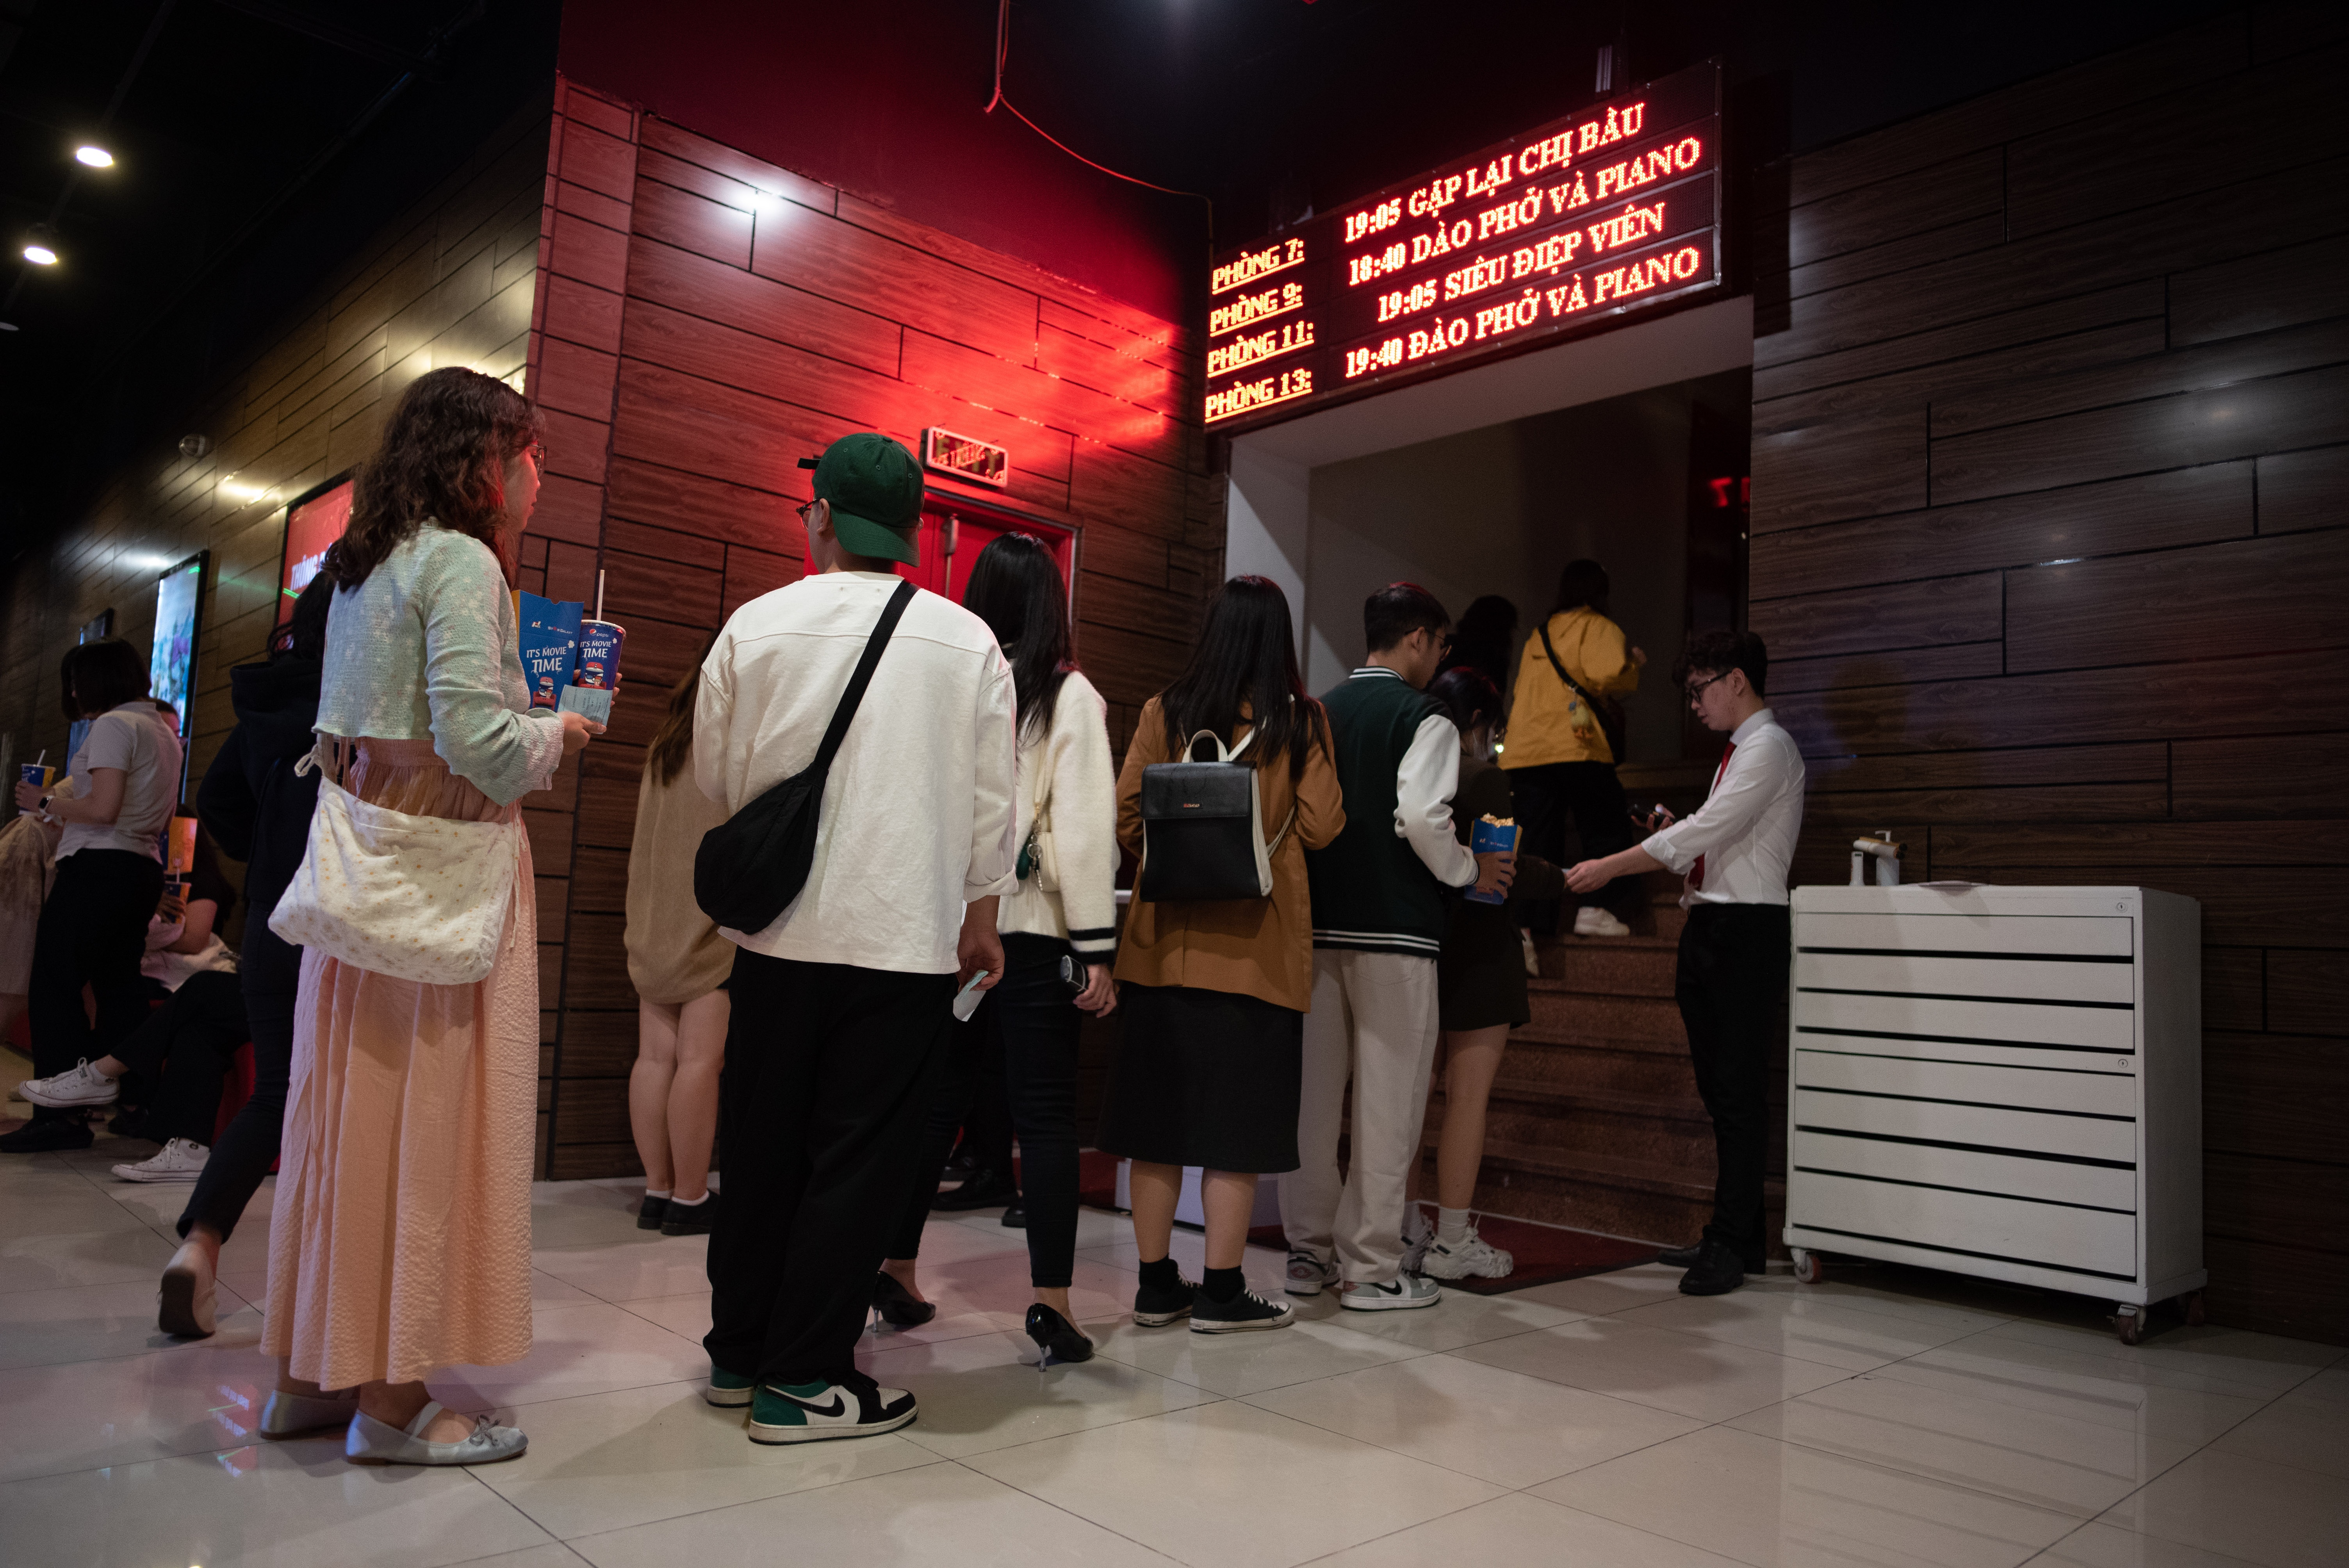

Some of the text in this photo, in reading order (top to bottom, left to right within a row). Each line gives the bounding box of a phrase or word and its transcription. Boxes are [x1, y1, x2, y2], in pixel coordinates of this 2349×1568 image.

[1346, 198, 1401, 242] 19:05
[1409, 175, 1461, 217] GẶP
[1466, 155, 1512, 197] LẠI
[1519, 130, 1573, 175] CHỊ
[1349, 243, 1406, 286] 18:40
[1478, 187, 1543, 241] PHỞ
[1548, 171, 1590, 214] VÀ
[1596, 137, 1700, 200] PIANO
[1212, 239, 1304, 290] PHÒNG 7:
[1378, 202, 1665, 322] 19:05 SIÊU ĐIỆP VIÊN
[1210, 283, 1302, 333] PHÒNG 9:
[1346, 247, 1699, 378] 19:40 ĐÀO PHỞ VÀ PIANO
[1208, 321, 1314, 372] PHÒNG 11:
[1205, 369, 1312, 418] PHÒNG 13:
[526, 646, 567, 658] IT'S MOVIE
[532, 657, 563, 673] TIME
[583, 648, 608, 658] TIME
